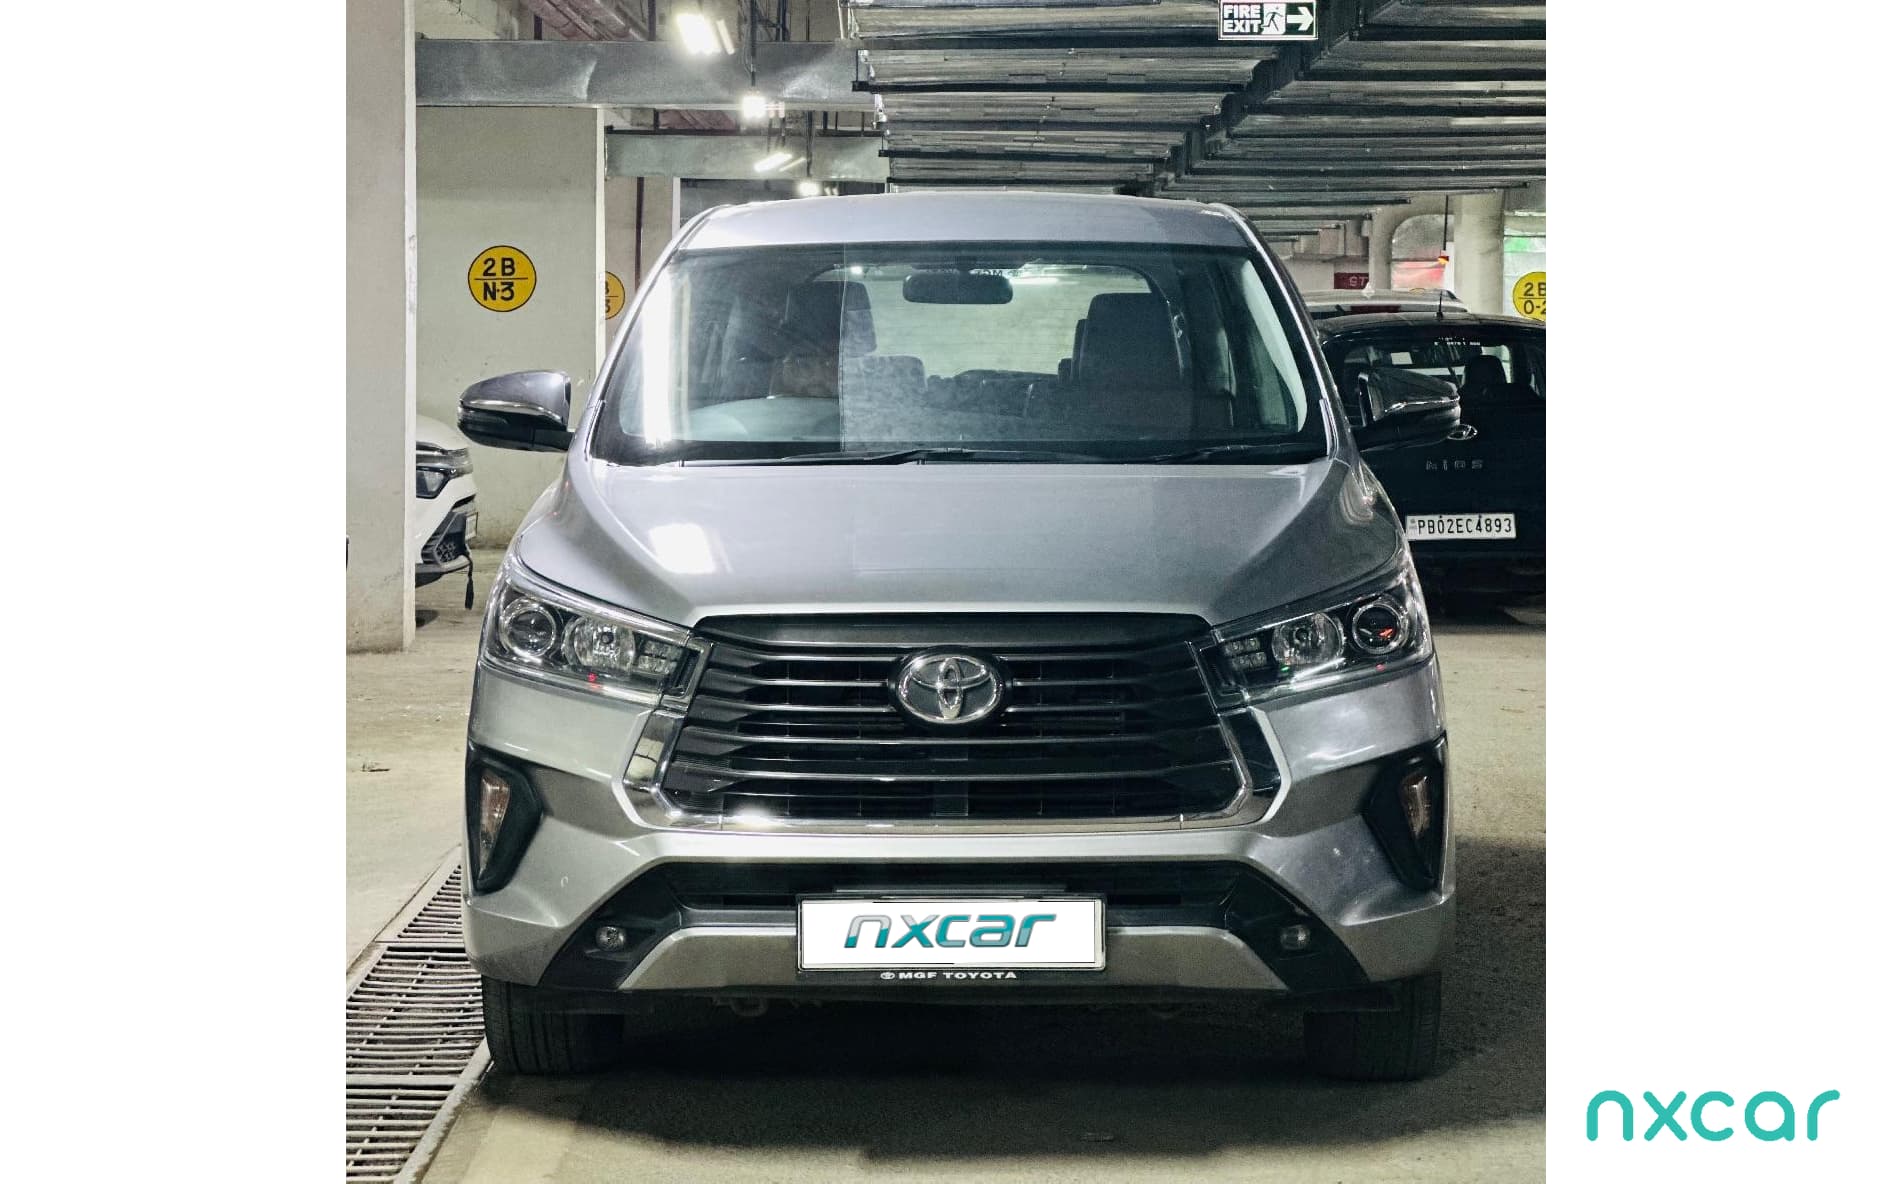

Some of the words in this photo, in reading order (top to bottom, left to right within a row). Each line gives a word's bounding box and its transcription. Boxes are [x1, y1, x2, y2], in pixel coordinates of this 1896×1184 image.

[1223, 4, 1261, 18] FIRE
[1223, 19, 1262, 33] EXIT
[1417, 517, 1512, 535] PB02EC4893
[898, 971, 937, 979] MGF
[943, 971, 1017, 979] TOYOTA
